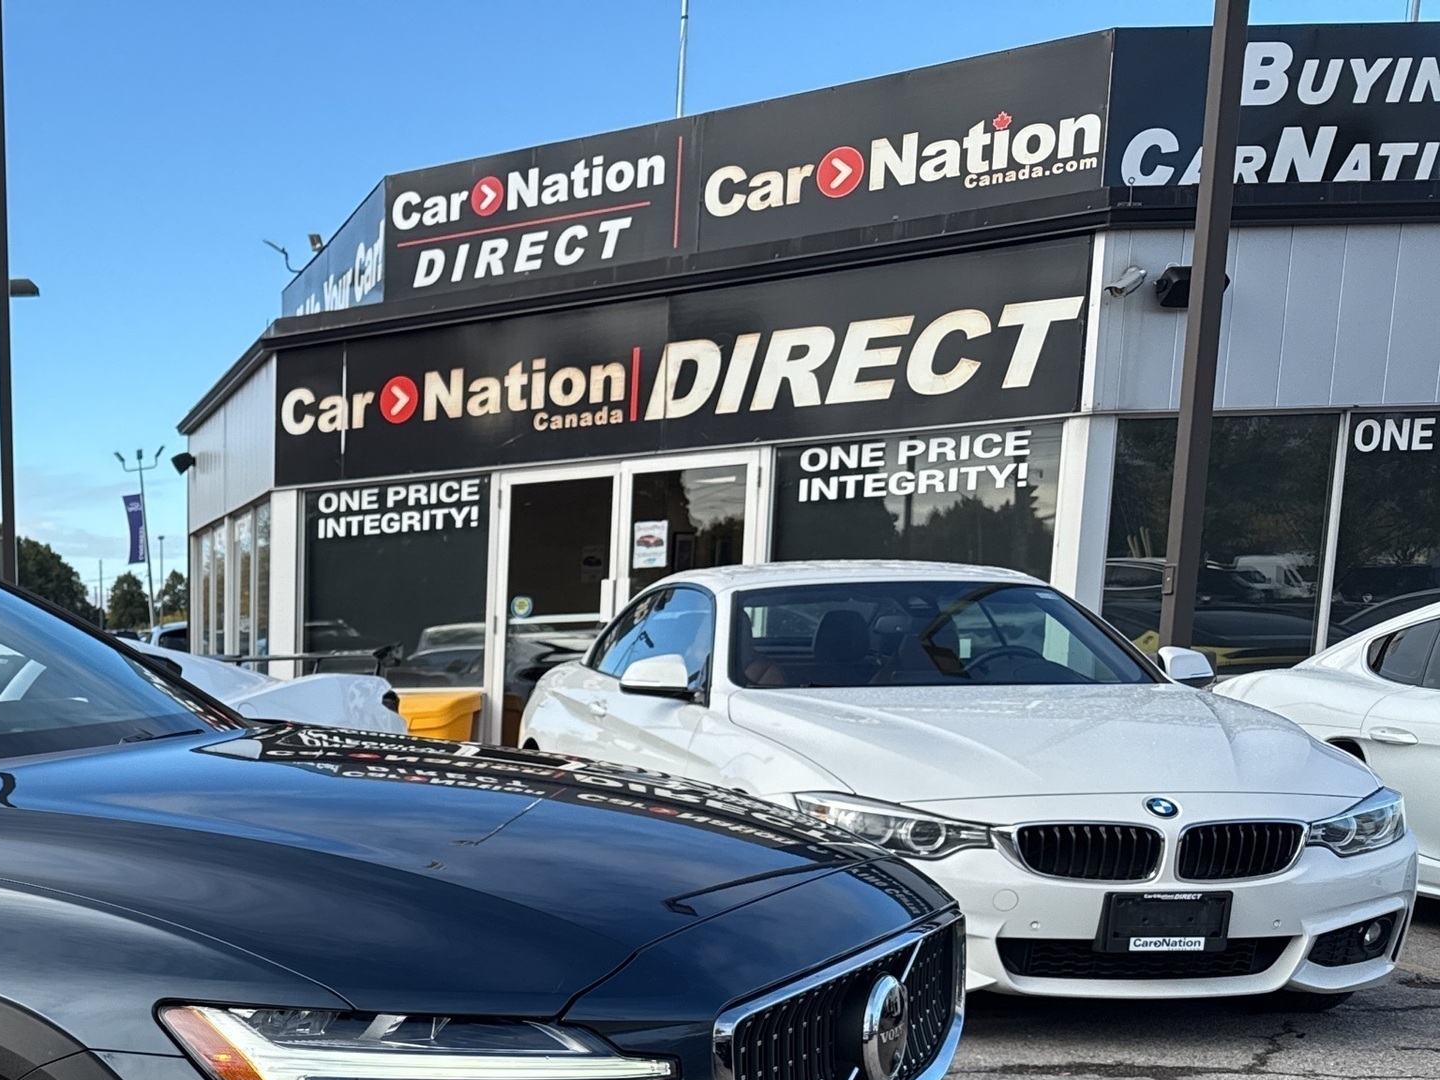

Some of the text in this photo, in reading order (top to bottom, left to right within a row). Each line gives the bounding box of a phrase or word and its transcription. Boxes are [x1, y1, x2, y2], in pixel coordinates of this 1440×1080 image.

[1240, 41, 1440, 106] BUYIN
[964, 154, 1098, 190] Canada.com
[413, 217, 632, 288] DIRECT
[644, 296, 1085, 421] DIRECT
[533, 406, 624, 431] Canada
[1354, 417, 1437, 452] ONE
[799, 430, 1032, 472] ONE PRICE
[318, 478, 481, 513] ONE PRICE
[798, 462, 1029, 502] INTEGRITY!
[317, 505, 479, 539] INTEGRITY!
